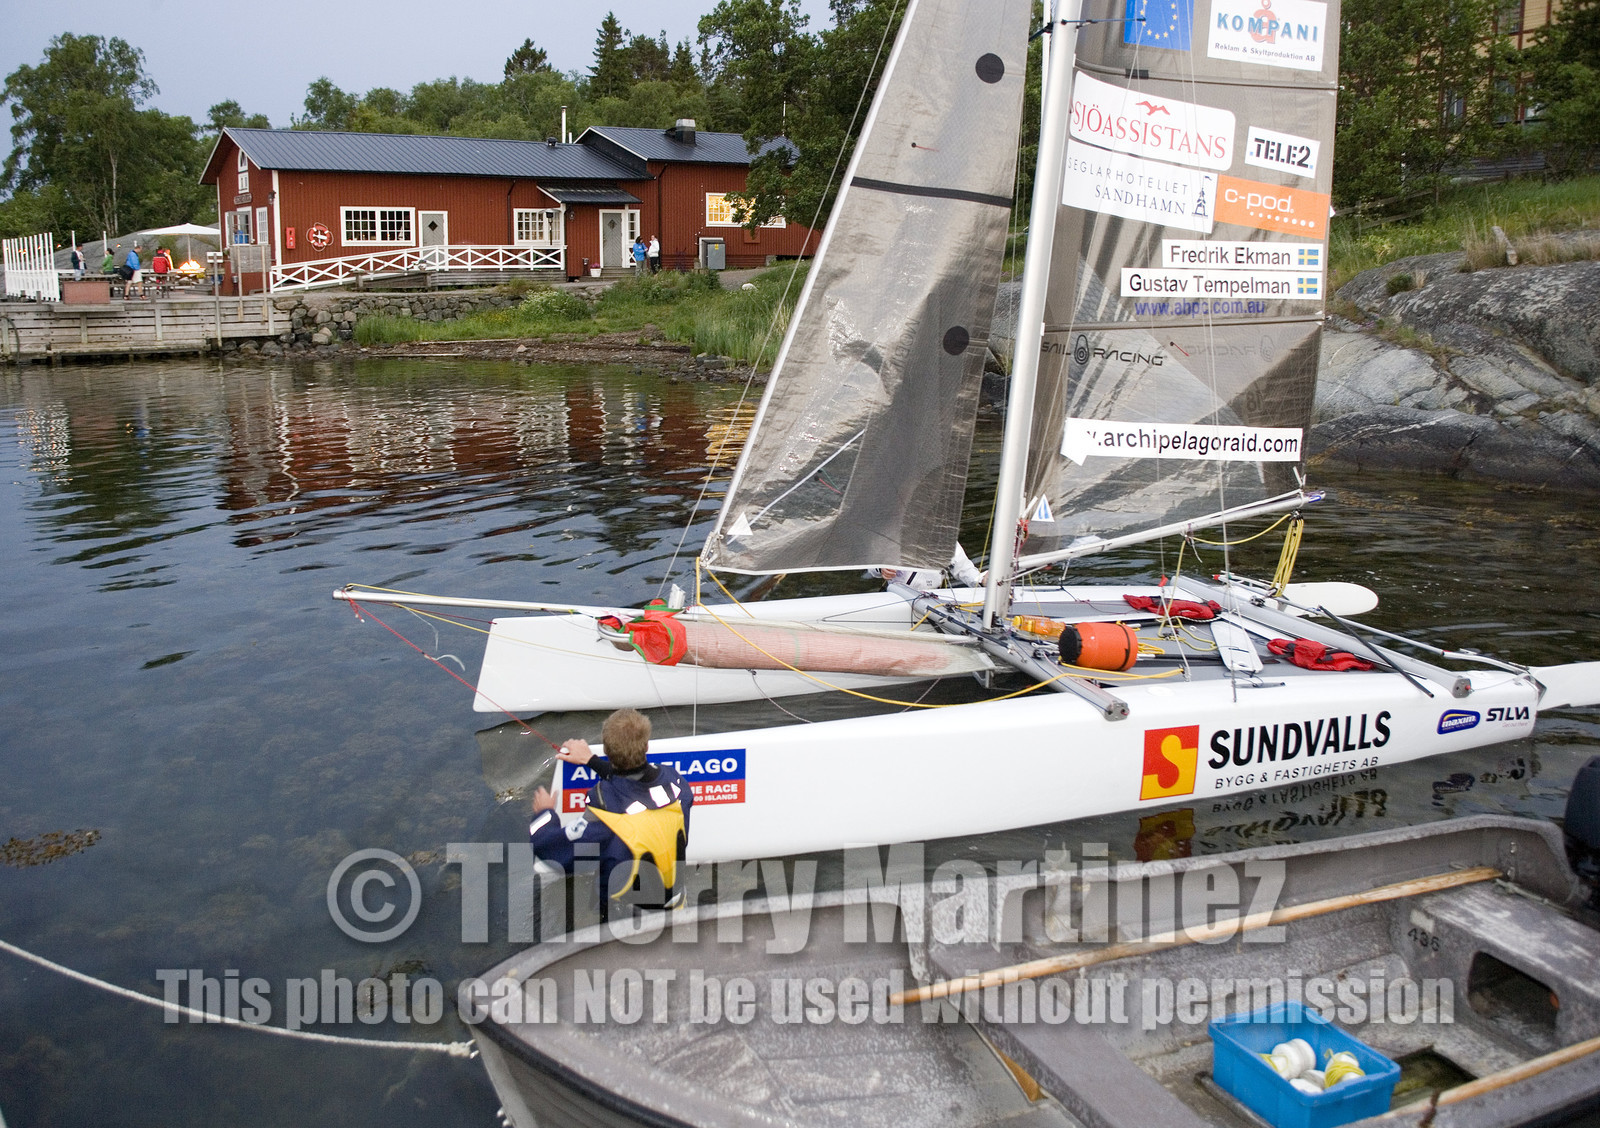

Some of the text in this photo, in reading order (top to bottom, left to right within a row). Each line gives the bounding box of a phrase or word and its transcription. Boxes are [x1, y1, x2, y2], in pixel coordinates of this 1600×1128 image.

[1217, 12, 1318, 42] KOMPANI
[1214, 42, 1240, 52] Reklam
[1250, 47, 1303, 61] Skyltproduktion
[1073, 100, 1227, 159] SJÖASSISTANS
[1254, 137, 1311, 168] TELE2
[1067, 157, 1188, 196] SEGLARHOTELLET
[1094, 184, 1186, 215] SANDHAMN
[1170, 245, 1291, 265] Fredrik Ekman
[1129, 273, 1291, 297] Gustav Tempelman
[1093, 347, 1163, 366] RACING
[1441, 715, 1477, 728] maxim
[1486, 706, 1529, 721] SILVA
[1207, 711, 1392, 770] SUNDVALLS
[1215, 756, 1379, 789] BYGG & FASTIGHETS AB
[706, 784, 738, 793] RACE
